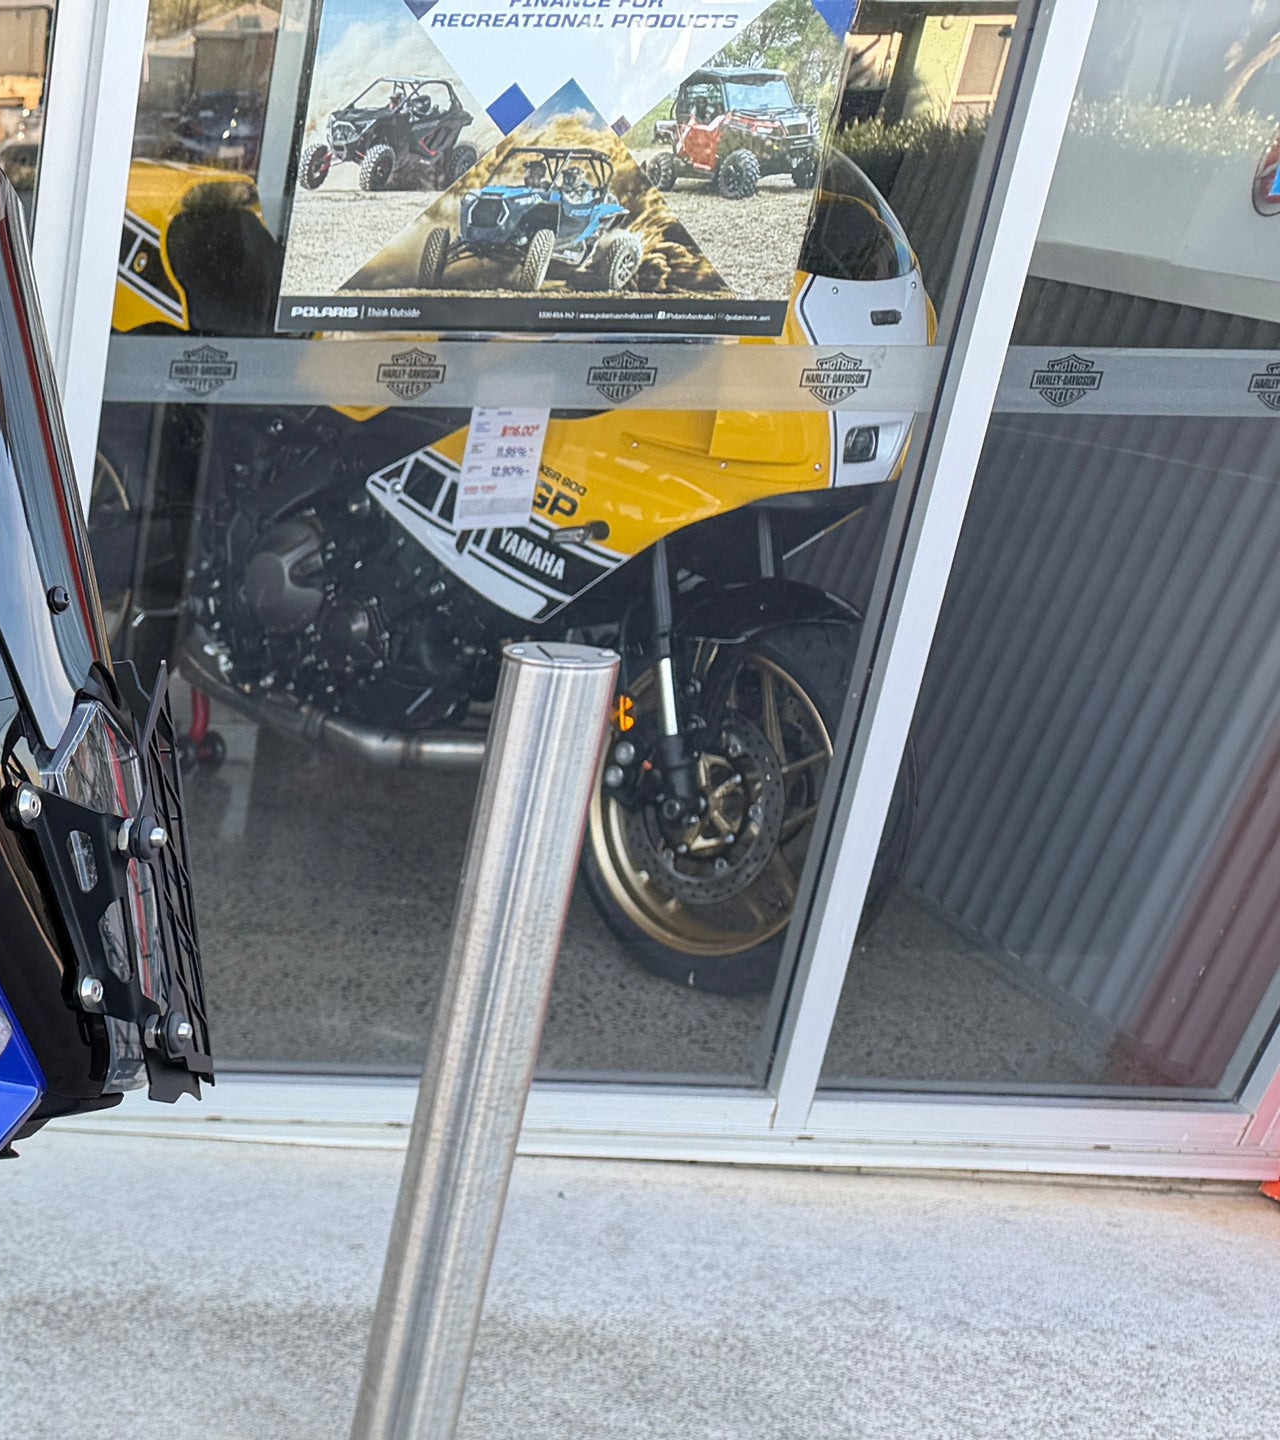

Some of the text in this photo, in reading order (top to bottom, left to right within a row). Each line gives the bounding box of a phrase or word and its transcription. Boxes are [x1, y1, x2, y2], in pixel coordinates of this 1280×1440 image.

[430, 13, 738, 28] RECREATIONAL PRODUCTS
[290, 306, 359, 318] POLARIS
[805, 372, 866, 386] HARLEY-DAVIDSON
[1034, 374, 1097, 387] HARLEY-DAVIDSON
[561, 476, 587, 497] 900
[533, 479, 579, 518] GP
[499, 528, 566, 580] YAMAHA
